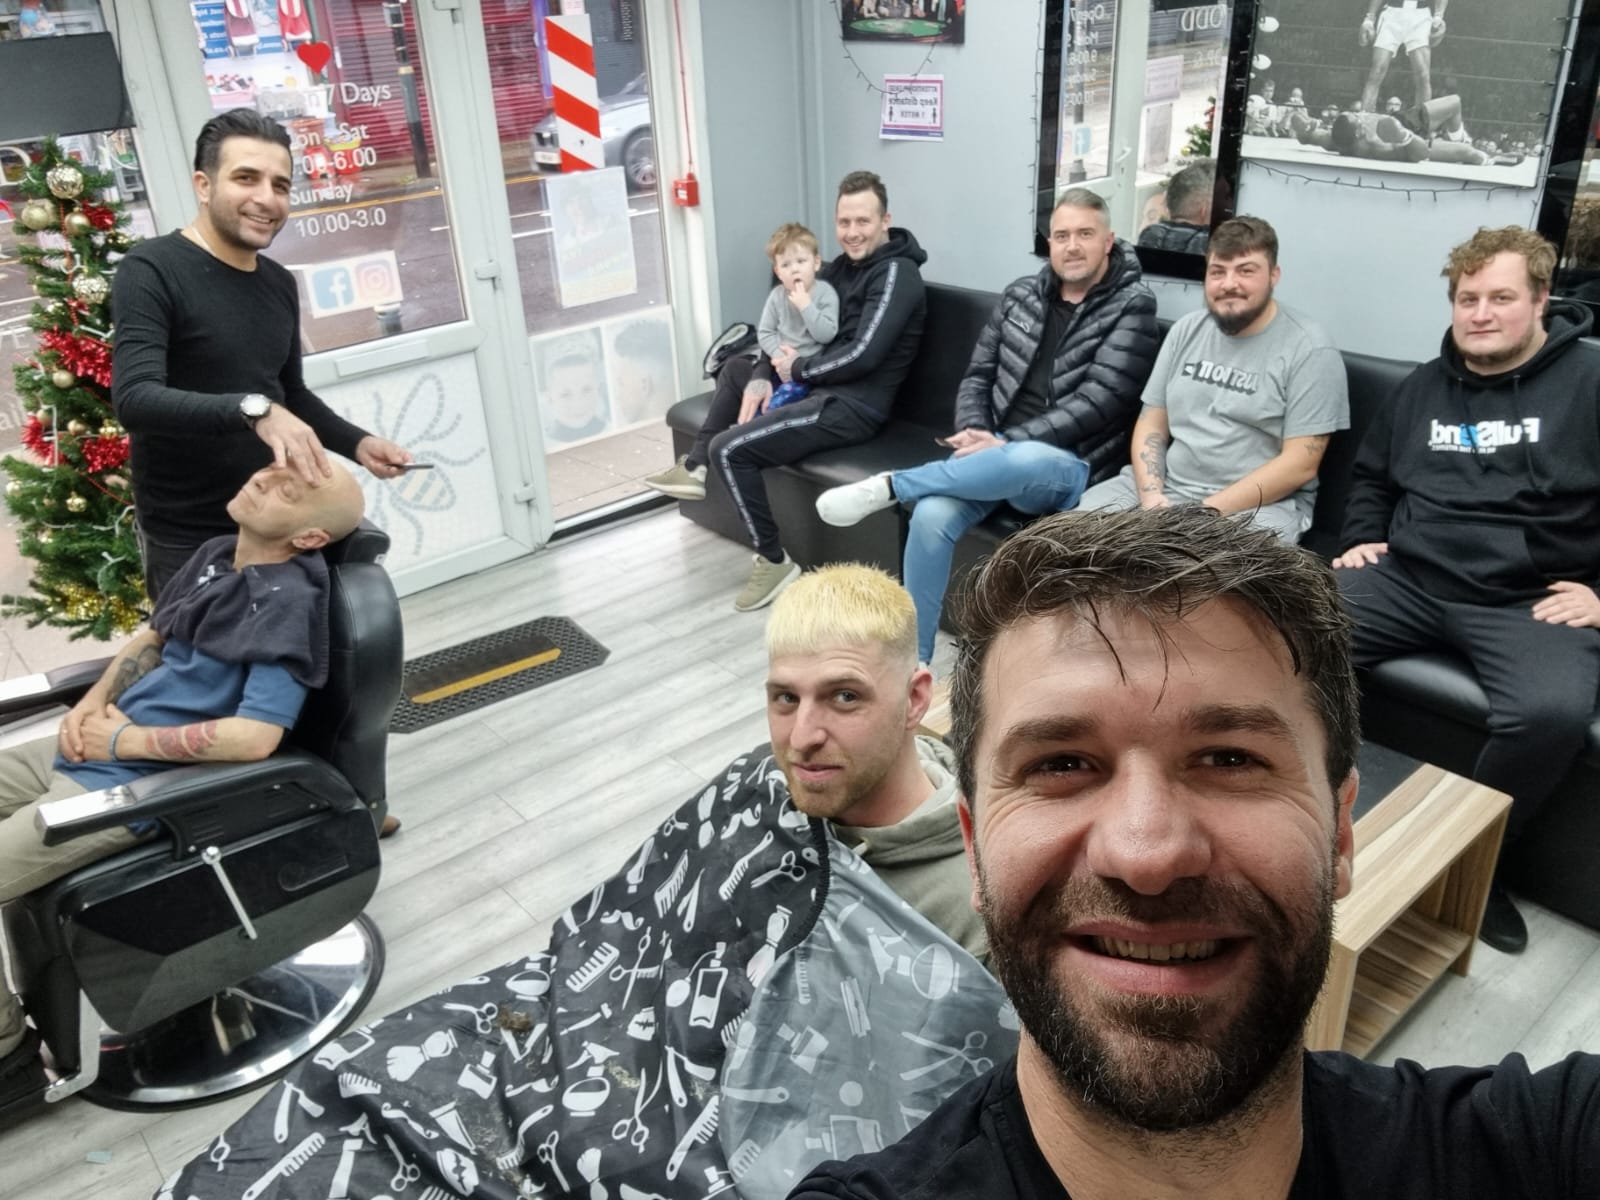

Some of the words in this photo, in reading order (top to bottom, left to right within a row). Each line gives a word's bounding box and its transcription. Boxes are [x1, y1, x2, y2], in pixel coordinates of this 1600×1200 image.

[340, 82, 391, 108] Days
[339, 122, 370, 140] Sat
[296, 147, 377, 175] .00-6.00
[290, 184, 354, 206] Sunday
[295, 207, 387, 238] 10.00-3.0
